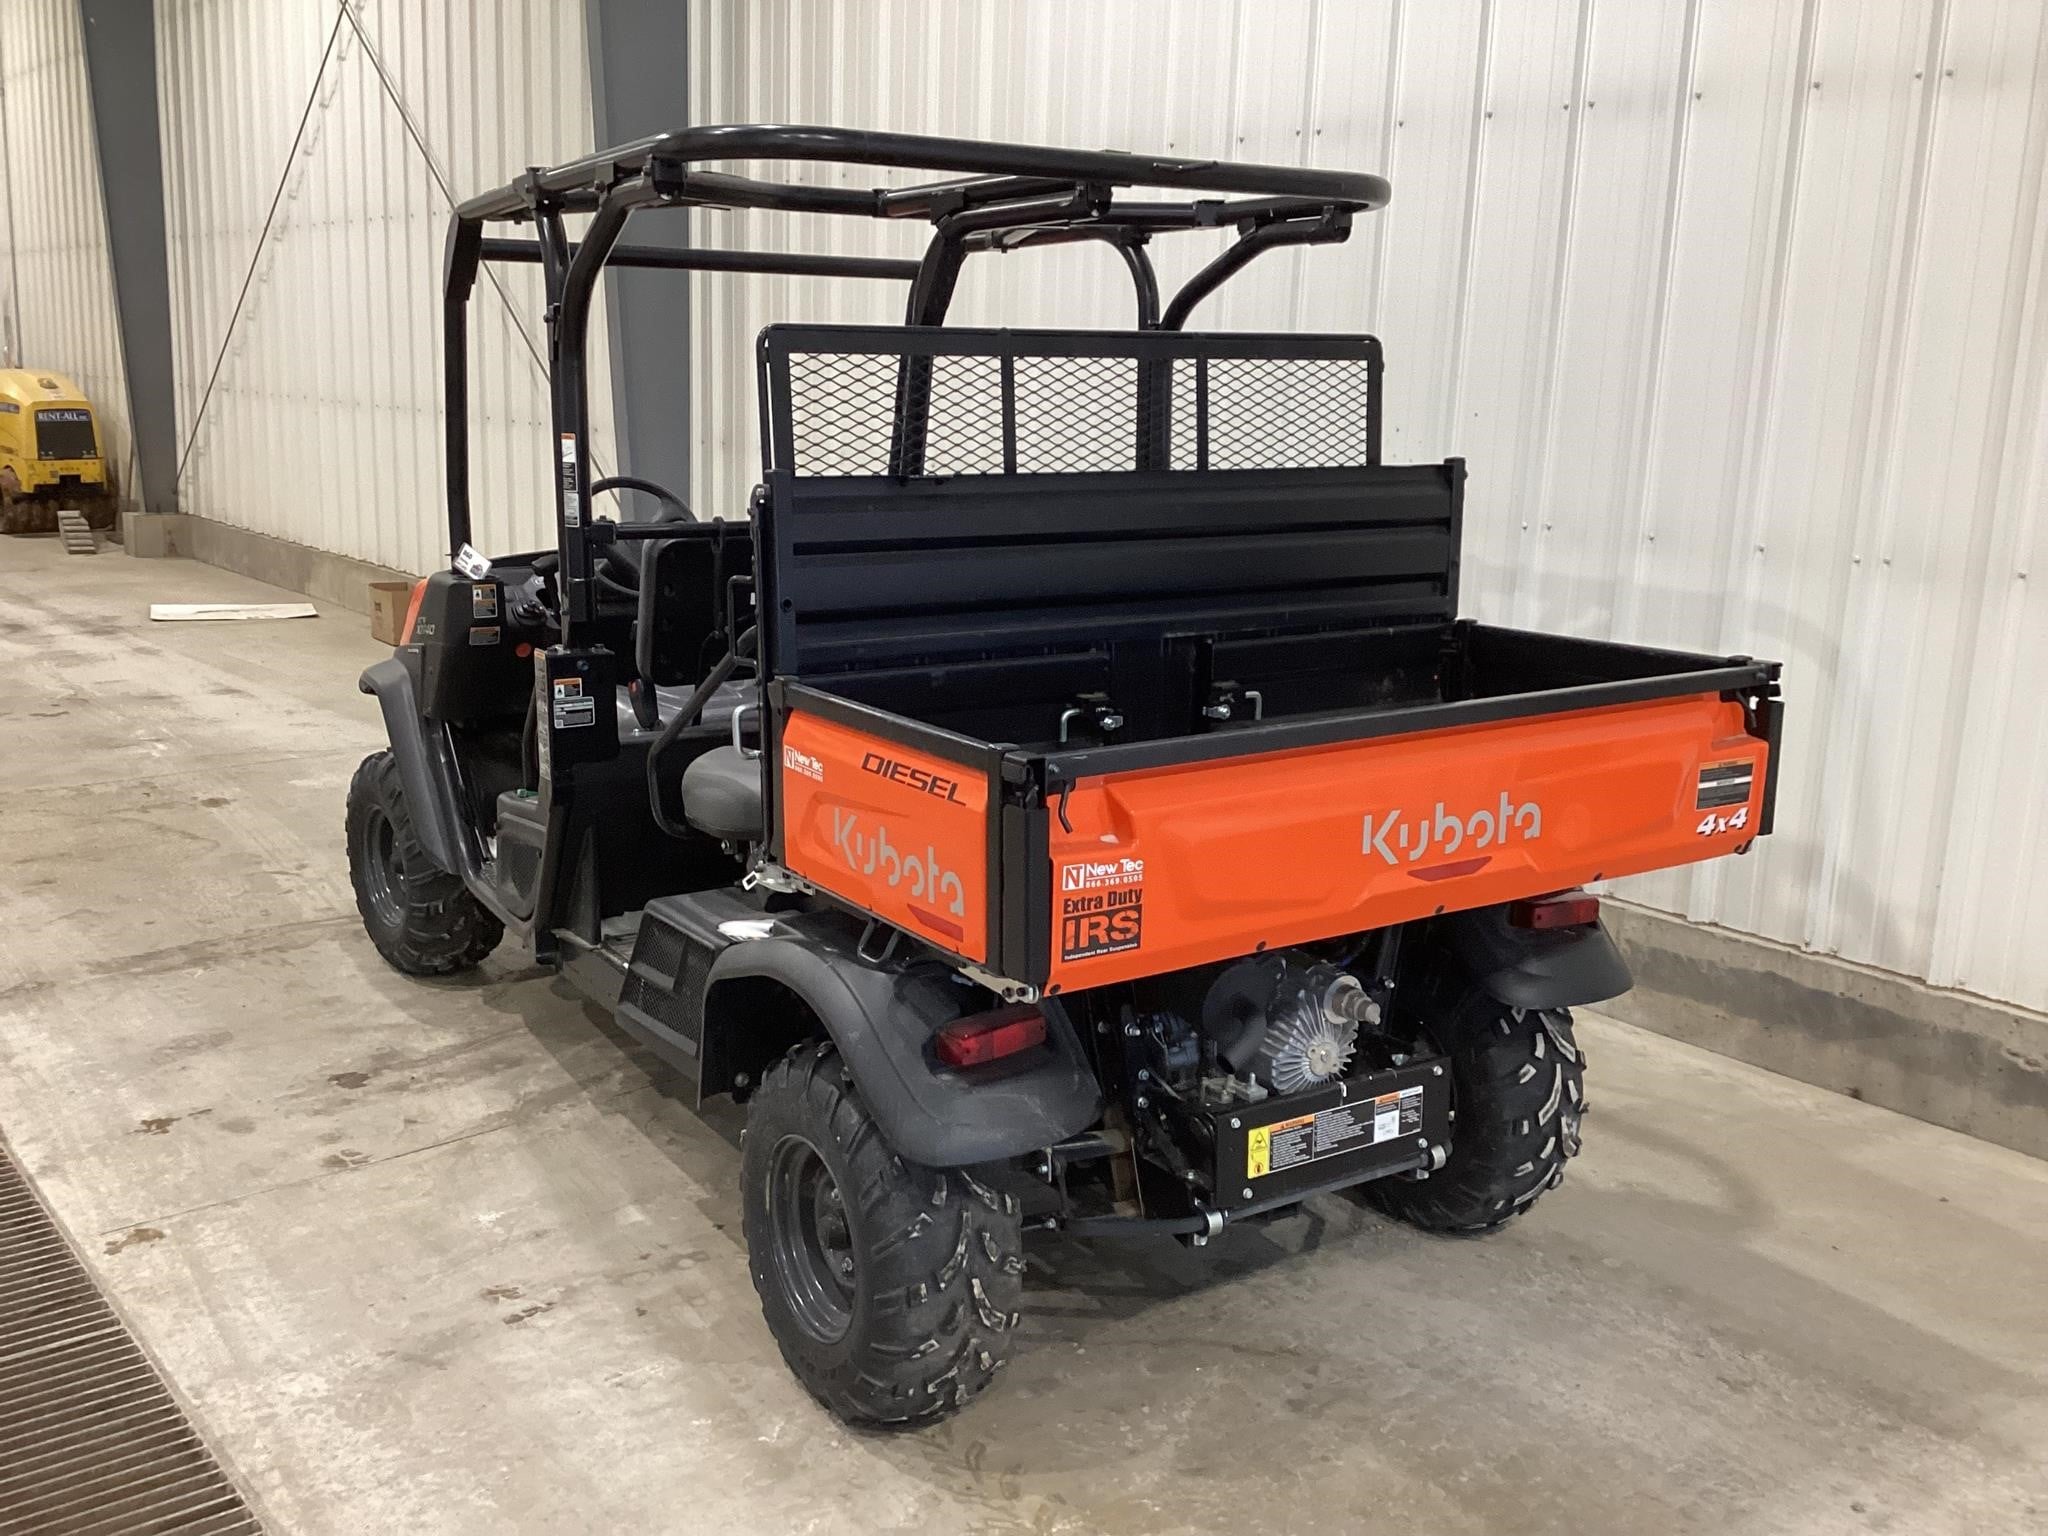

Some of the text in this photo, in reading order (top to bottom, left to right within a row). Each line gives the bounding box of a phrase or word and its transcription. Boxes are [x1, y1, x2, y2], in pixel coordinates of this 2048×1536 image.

[861, 752, 967, 807] DIESEL
[1362, 791, 1542, 865] Kubota
[1696, 807, 1749, 836] 4x4
[834, 808, 964, 916] Kubota
[1086, 858, 1144, 876] New Tec
[1063, 889, 1142, 914] Extra Duty
[1065, 909, 1139, 950] IRS
